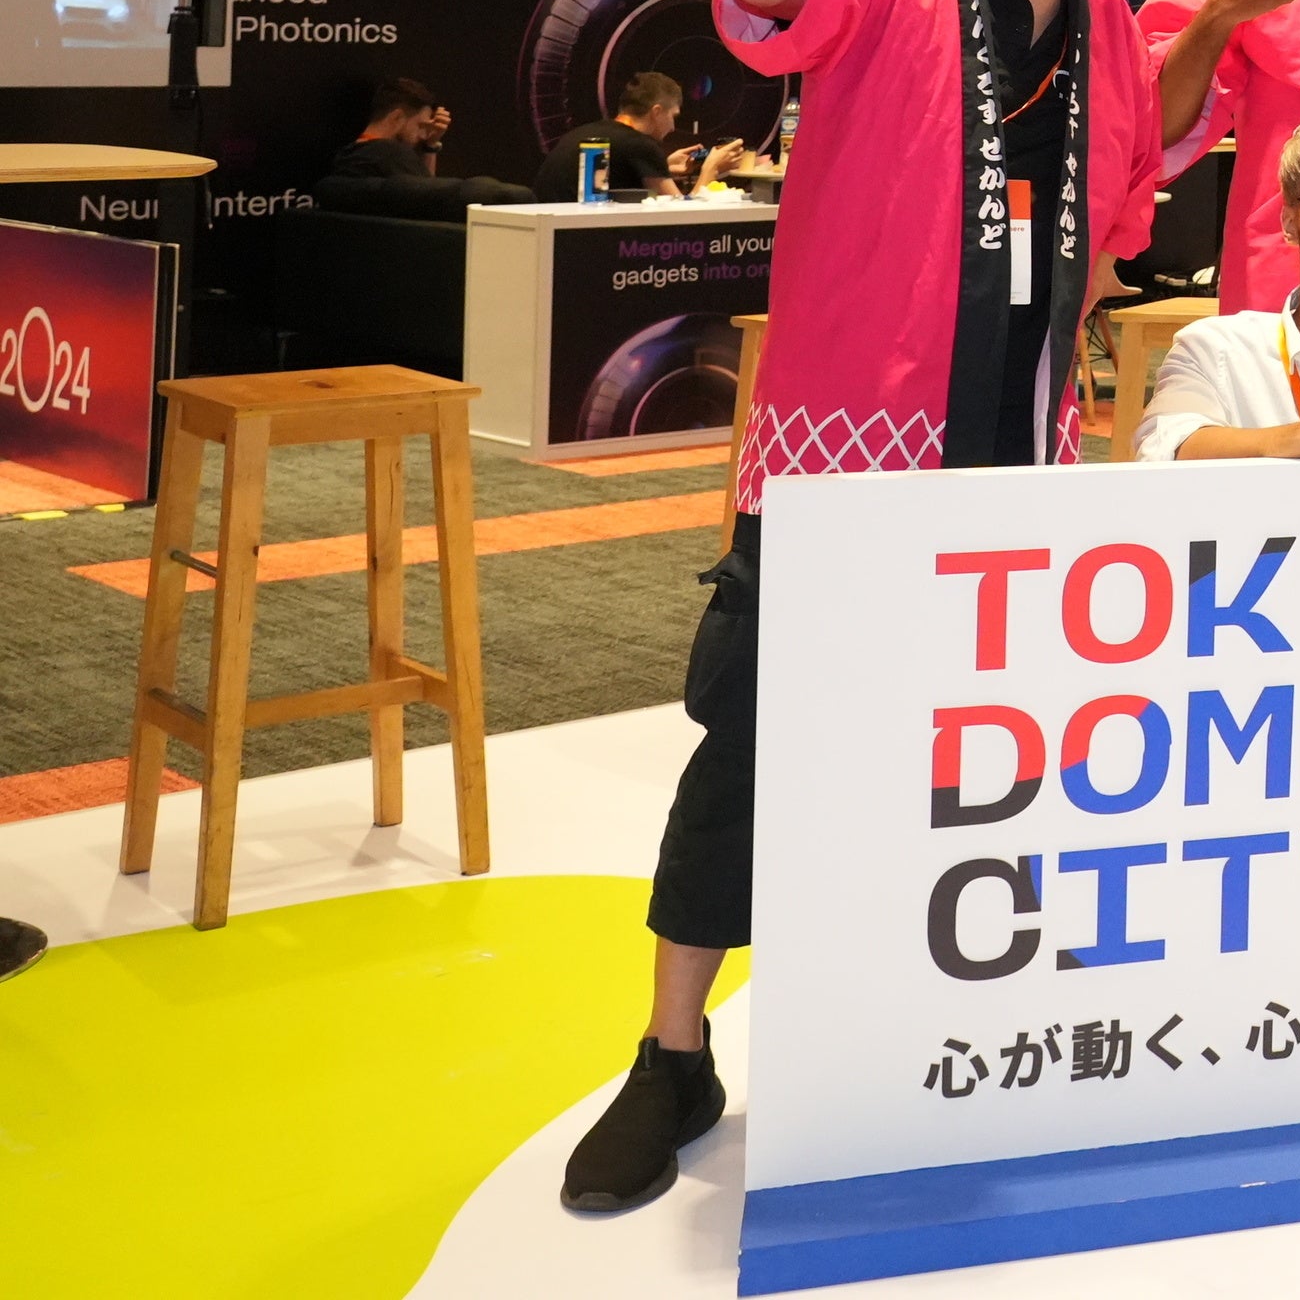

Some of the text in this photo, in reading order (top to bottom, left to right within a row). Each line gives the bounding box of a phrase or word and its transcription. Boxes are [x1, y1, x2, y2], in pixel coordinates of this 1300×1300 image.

[236, 15, 398, 44] Photonics
[209, 188, 319, 217] nterfa
[979, 136, 1007, 250] せかんど
[619, 239, 704, 260] Merging
[709, 234, 732, 254] all
[612, 263, 770, 290] gadgets into on
[0, 306, 91, 415] 2024
